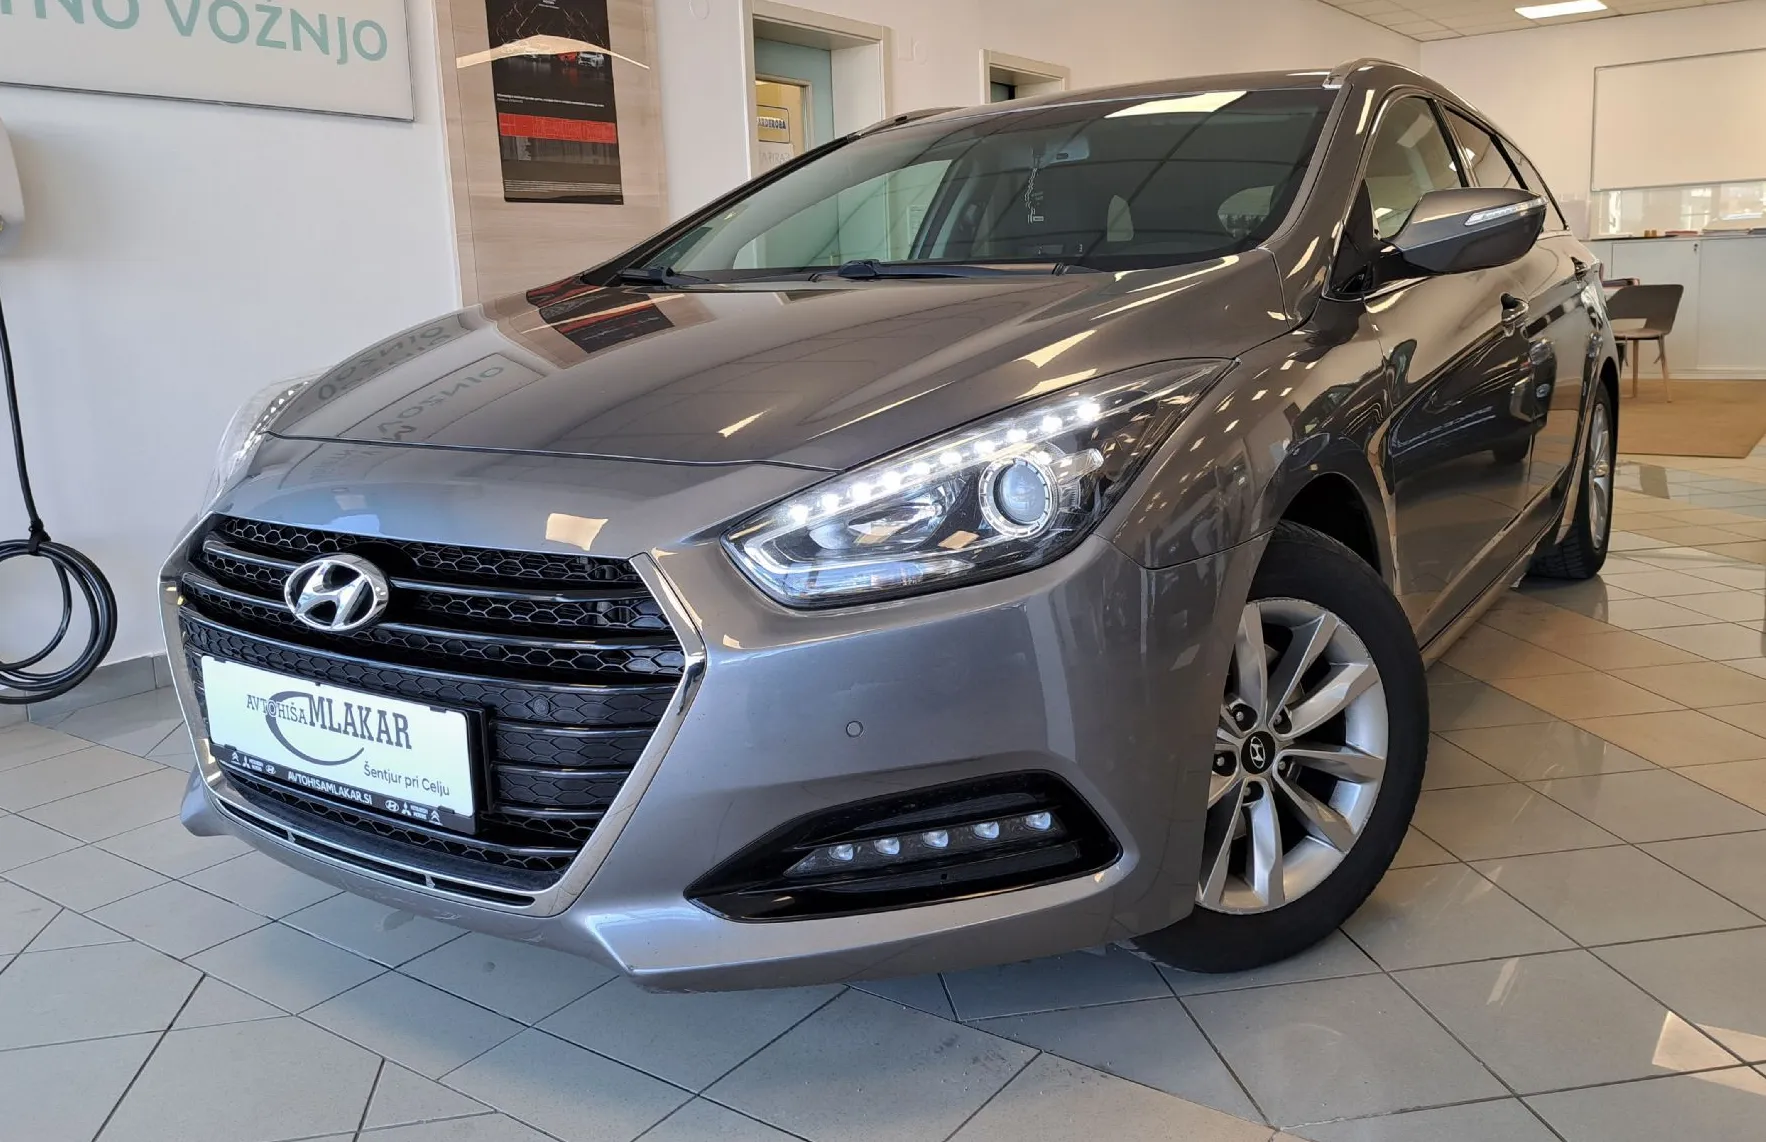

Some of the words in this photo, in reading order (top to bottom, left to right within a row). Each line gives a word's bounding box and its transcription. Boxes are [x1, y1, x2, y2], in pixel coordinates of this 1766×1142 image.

[0, 0, 140, 30] NO
[246, 694, 308, 725] AVTOHIŠA
[308, 694, 413, 750] MLAKAR
[287, 770, 373, 806] AVTOHISAMLAKAR.SI
[363, 760, 402, 784] Šentjur
[404, 776, 419, 789] pri
[421, 777, 450, 797] Celju
